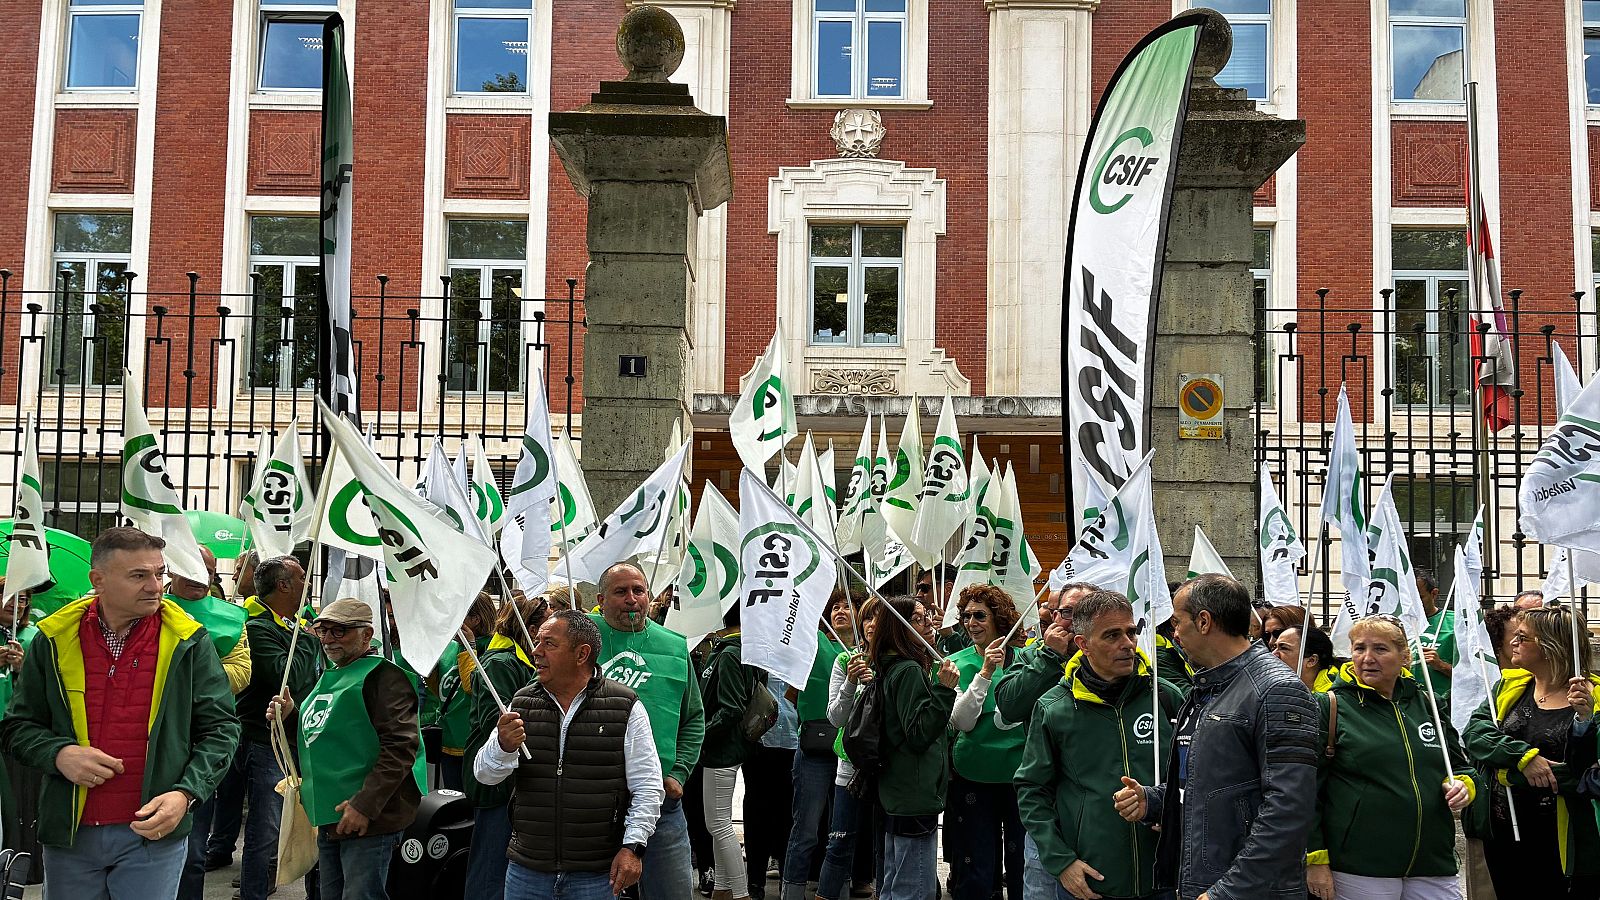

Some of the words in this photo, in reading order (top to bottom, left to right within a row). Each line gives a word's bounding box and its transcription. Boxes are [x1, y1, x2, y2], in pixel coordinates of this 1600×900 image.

[1103, 154, 1160, 187] CSIF
[630, 358, 636, 375] 1
[1077, 264, 1138, 492] CSIF
[606, 665, 653, 689] CSIF
